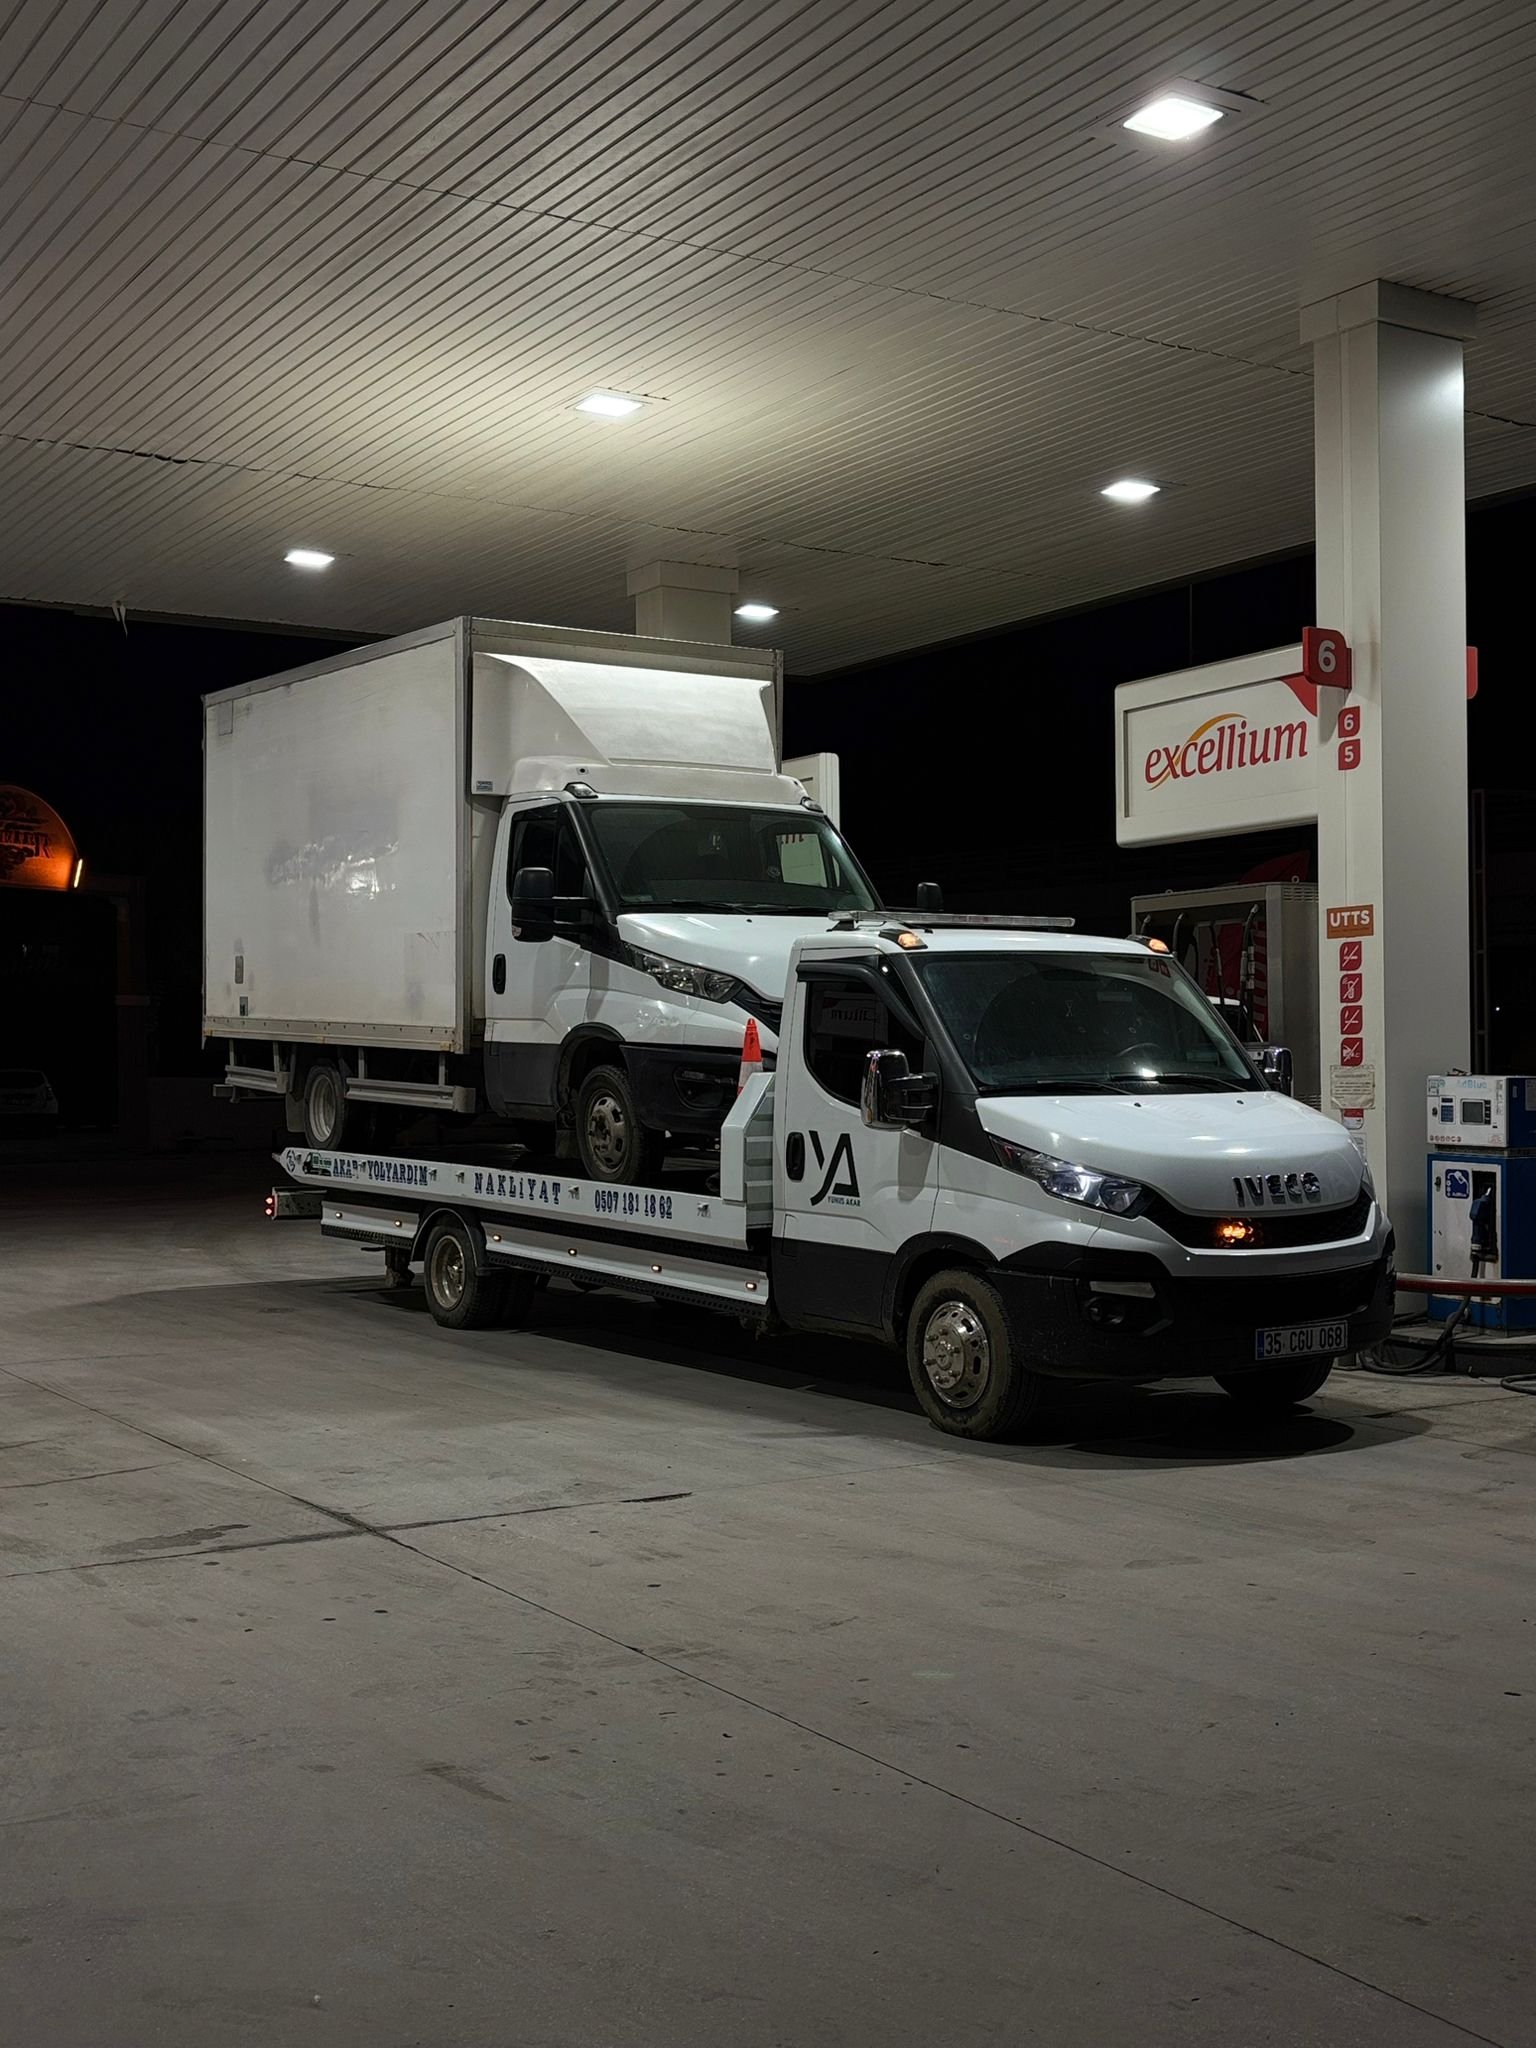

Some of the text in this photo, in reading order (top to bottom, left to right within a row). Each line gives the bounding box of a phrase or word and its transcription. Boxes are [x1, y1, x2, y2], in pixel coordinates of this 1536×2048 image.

[1318, 639, 1336, 673] 6
[1343, 713, 1354, 731] 6
[1144, 718, 1308, 786] excellium
[1343, 745, 1354, 763] 5
[1329, 909, 1370, 928] UTTS
[367, 1160, 428, 1186] YOLYARDIM
[594, 1190, 619, 1214] 0507
[622, 1192, 640, 1215] 181
[644, 1194, 656, 1218] 18
[659, 1195, 673, 1219] 62
[1232, 1172, 1321, 1199] IVECO
[1265, 1326, 1343, 1355] 35 CGU 068
